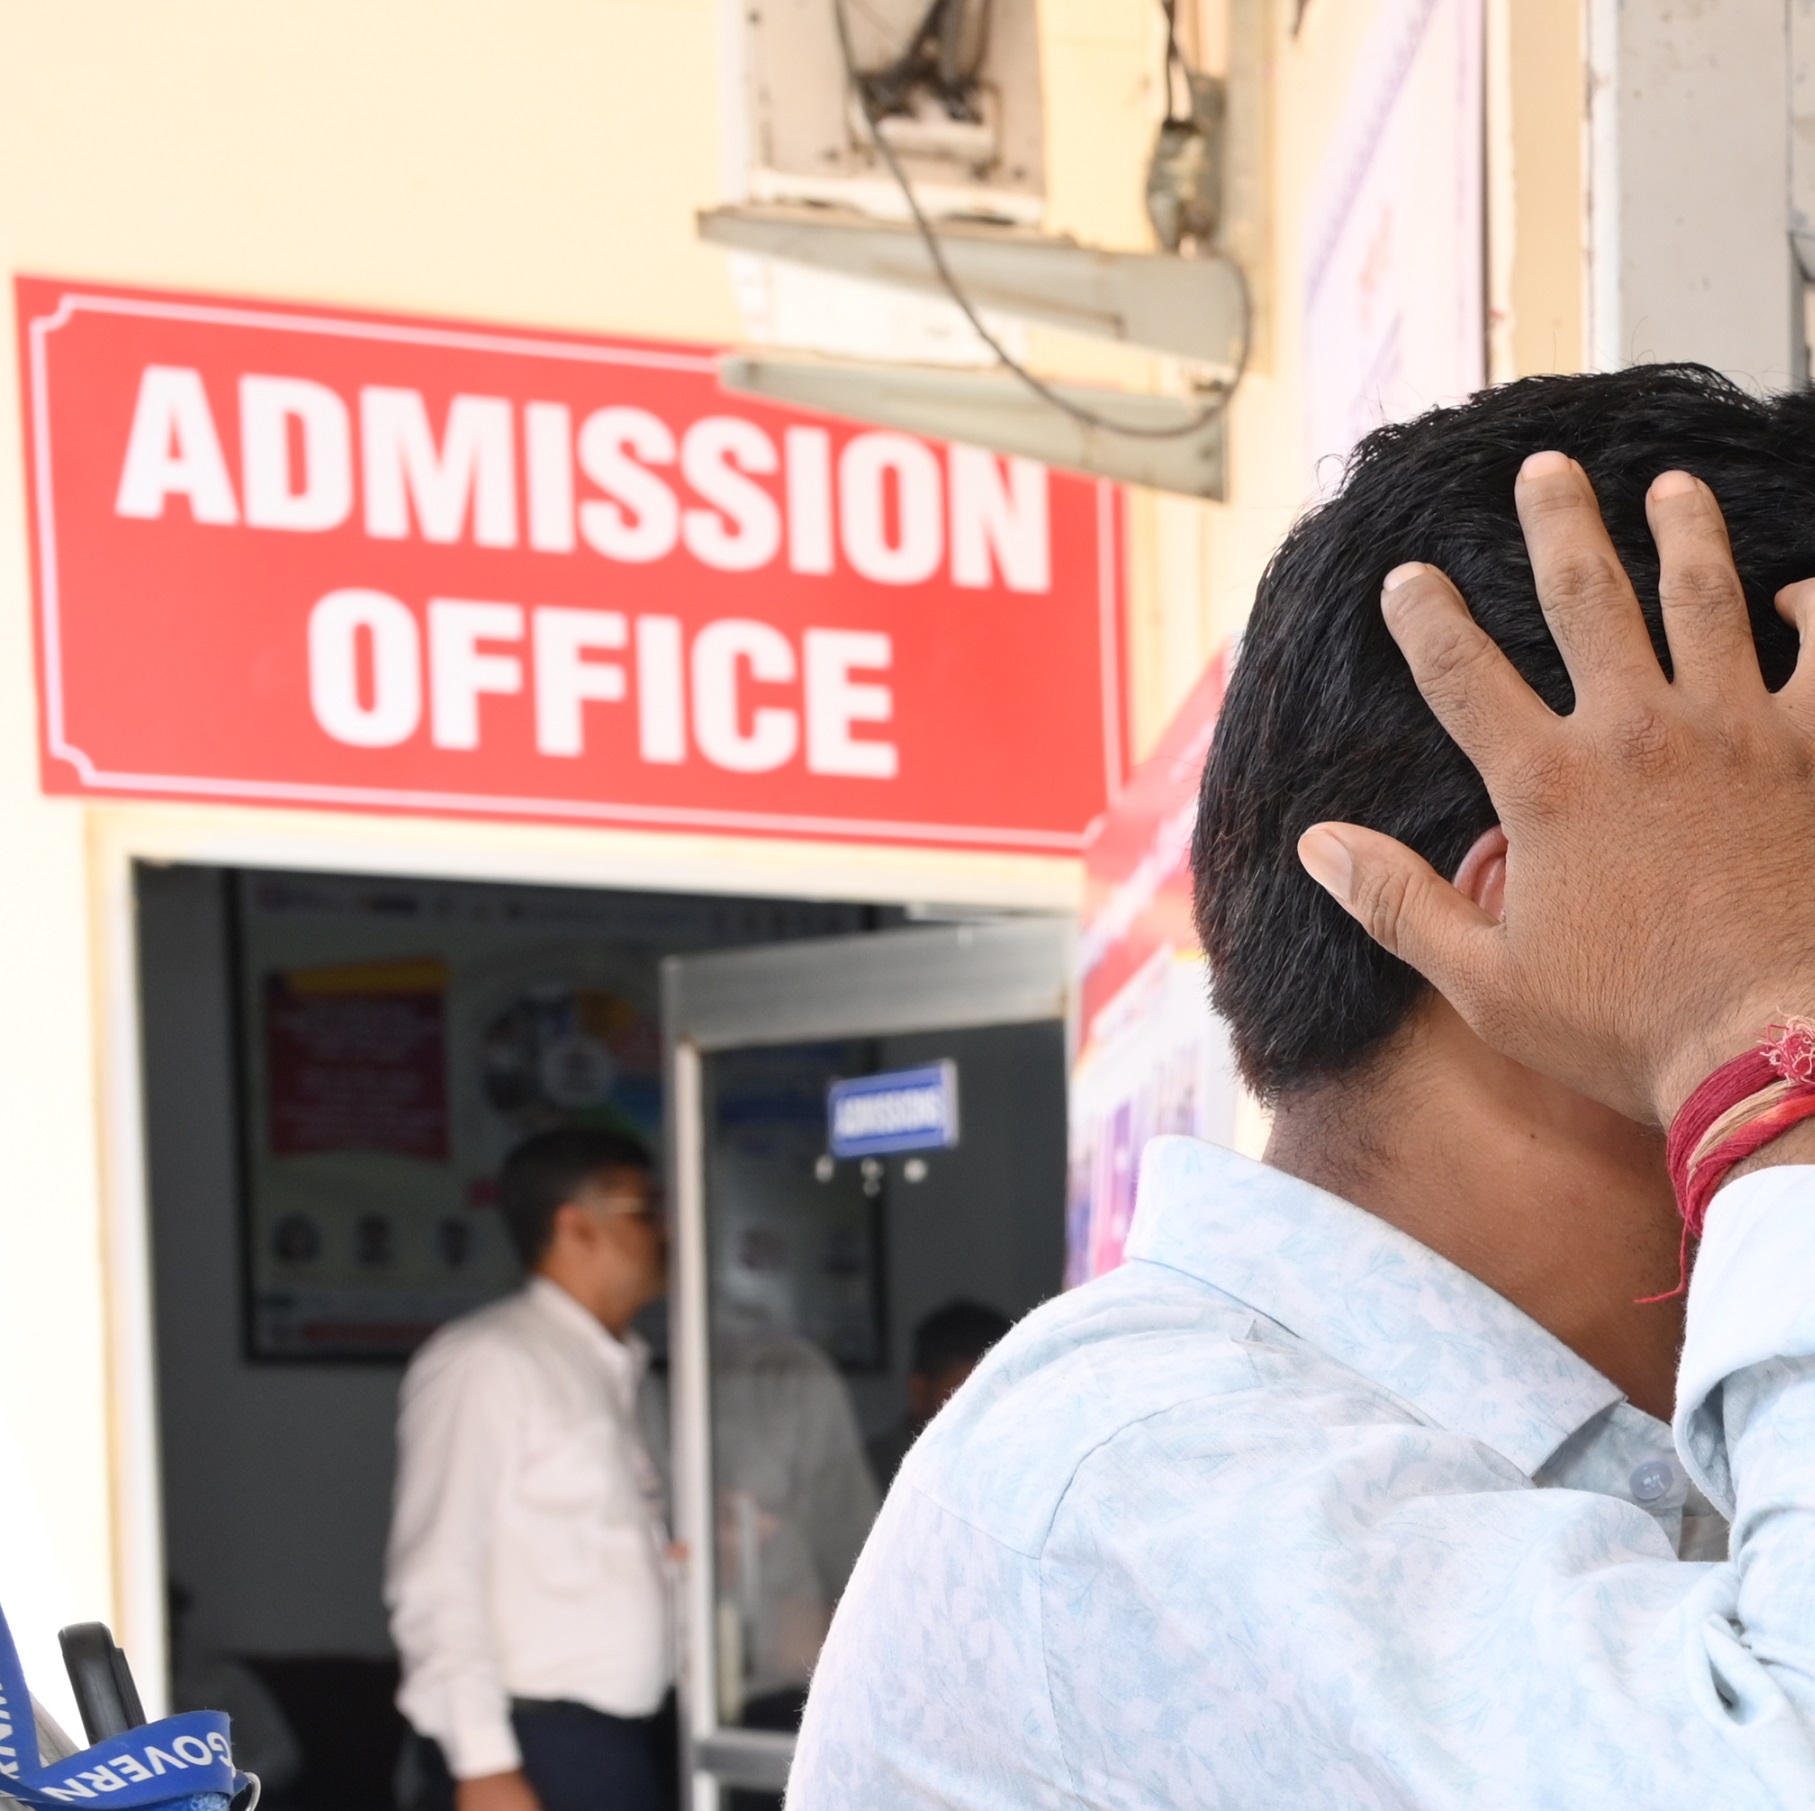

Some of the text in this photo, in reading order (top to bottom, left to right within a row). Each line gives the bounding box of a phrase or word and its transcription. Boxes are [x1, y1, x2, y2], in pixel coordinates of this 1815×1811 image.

[114, 364, 1052, 594] ADMISSION
[307, 588, 899, 779] OFFICE
[41, 1730, 237, 1802] GOVERN
